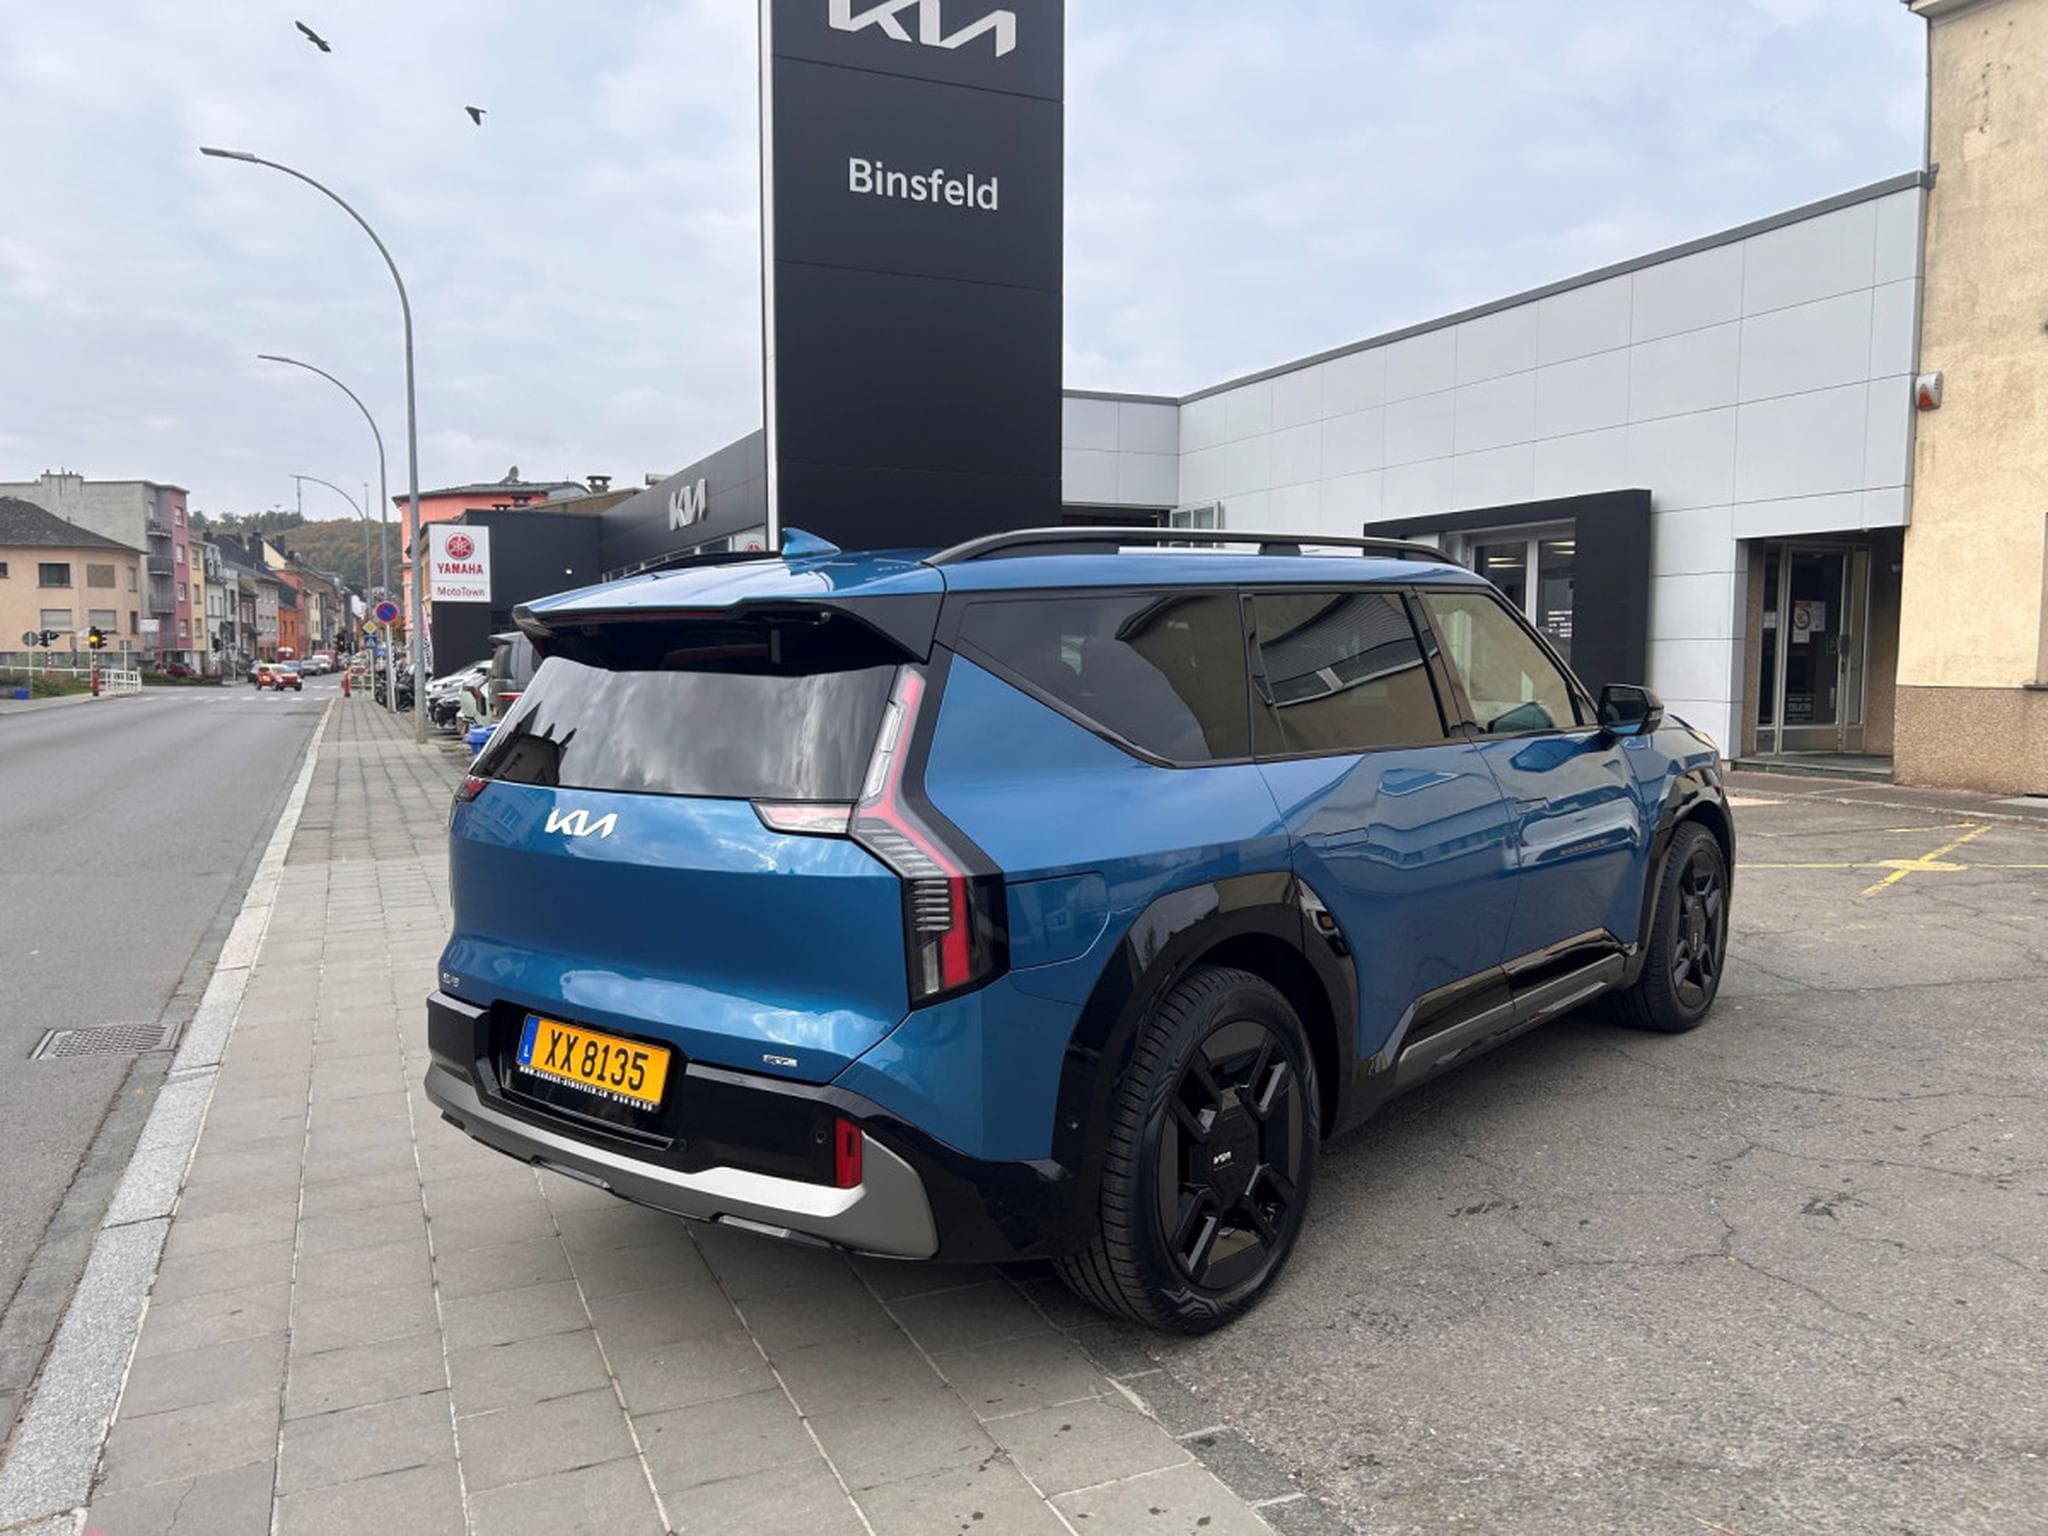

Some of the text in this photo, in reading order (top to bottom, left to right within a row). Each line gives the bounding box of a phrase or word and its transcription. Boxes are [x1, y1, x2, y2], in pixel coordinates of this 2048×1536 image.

[849, 157, 998, 211] Binsfeld
[669, 478, 706, 531] KIA
[437, 563, 484, 575] YAMAHA
[437, 586, 485, 597] MotoTown
[544, 807, 618, 839] KIA
[545, 1029, 649, 1092] XX 8135
